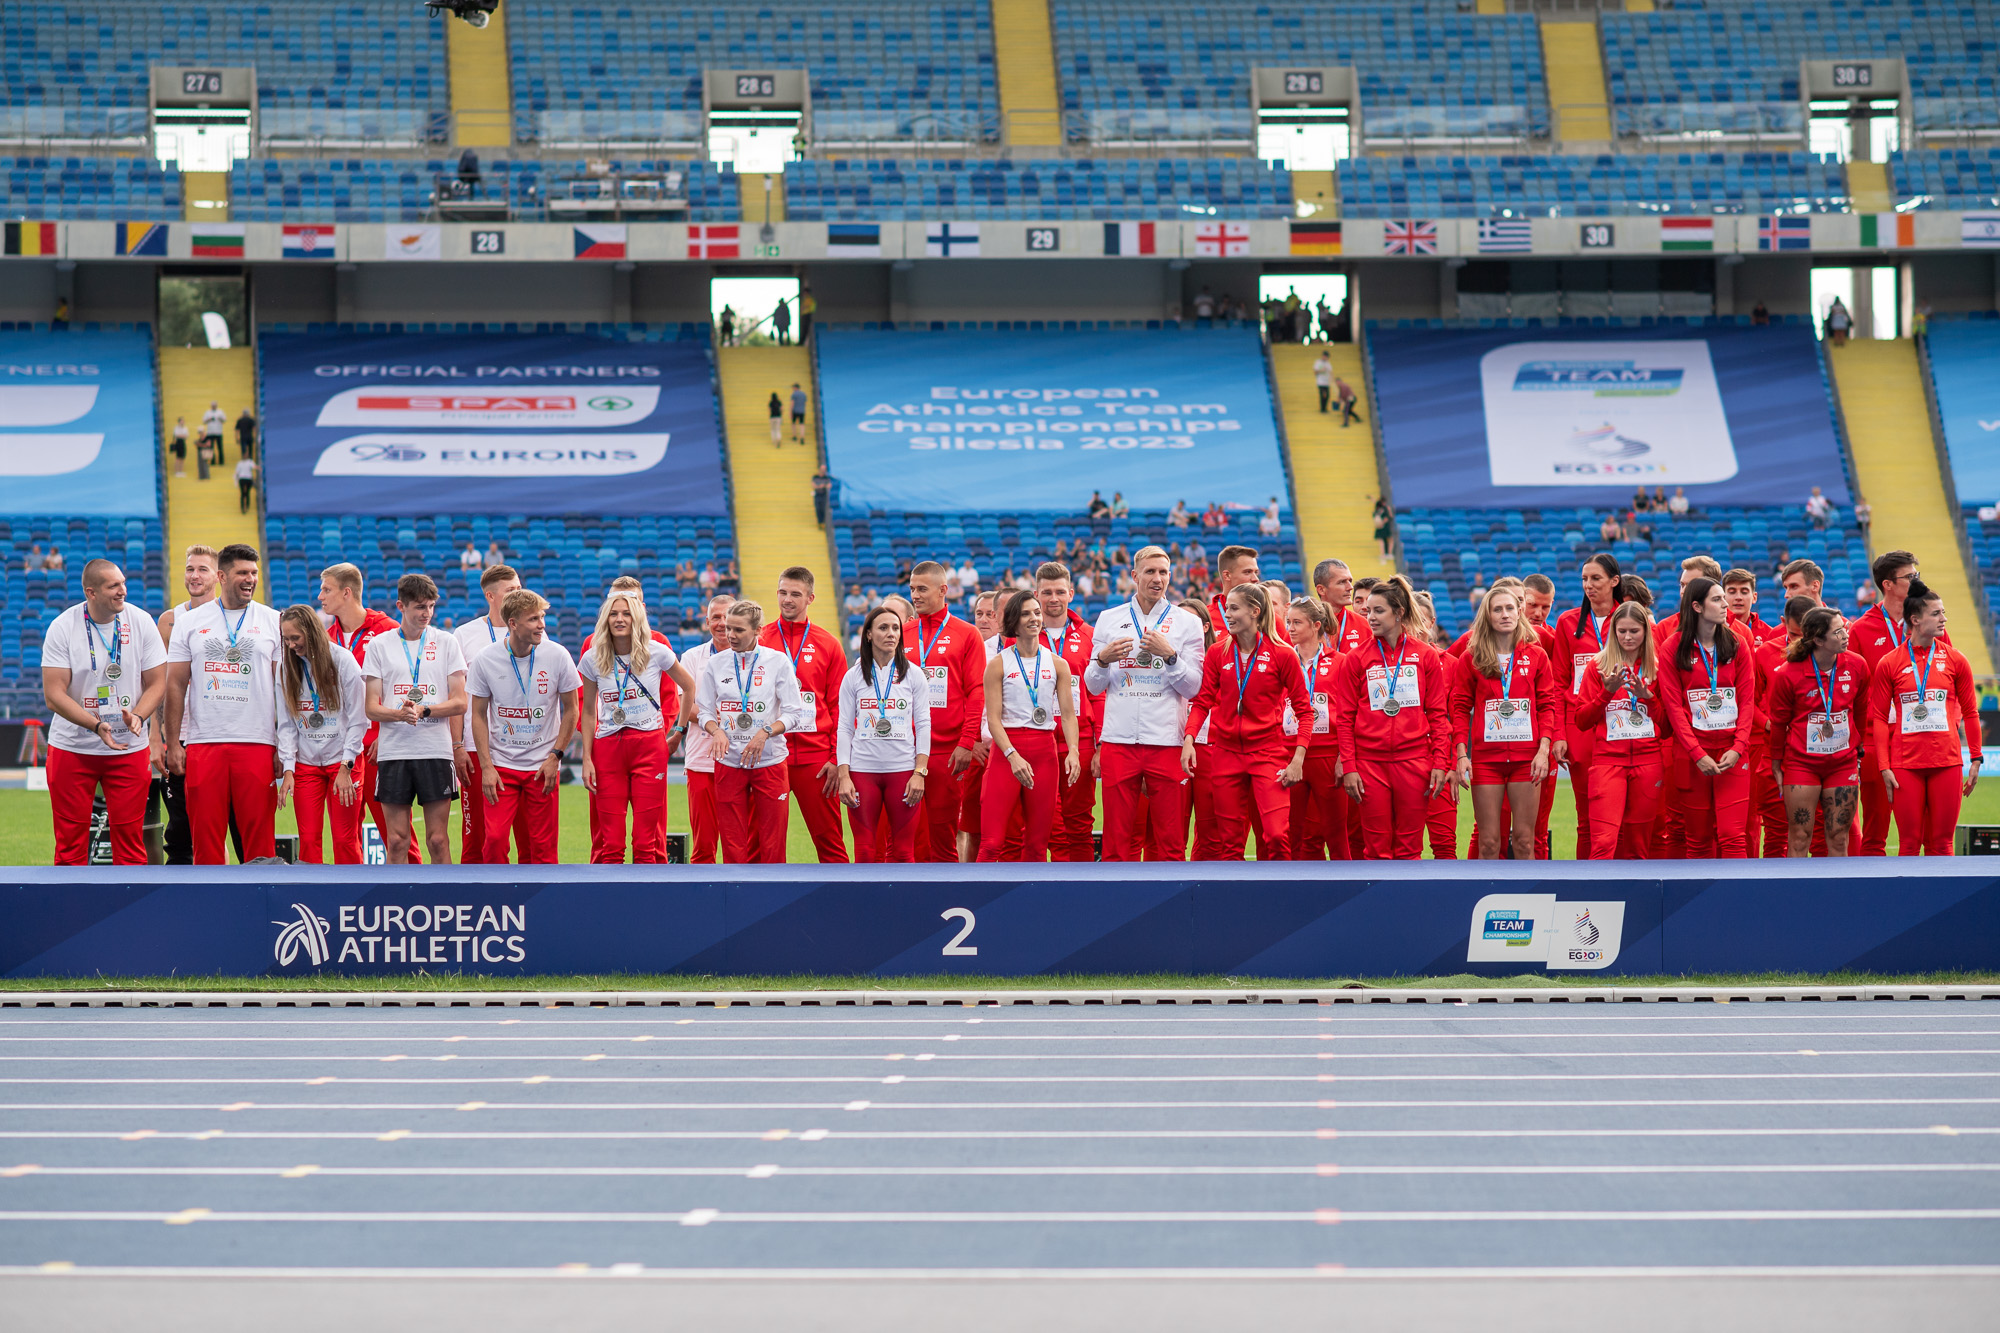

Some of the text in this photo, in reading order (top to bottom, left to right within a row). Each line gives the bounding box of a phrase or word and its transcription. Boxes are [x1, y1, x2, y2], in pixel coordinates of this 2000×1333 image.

[186, 74, 206, 91] 27
[1288, 75, 1307, 91] 29
[1836, 67, 1856, 84] 30
[739, 78, 758, 94] 28
[476, 232, 500, 252] 28
[1032, 230, 1054, 249] 29
[1586, 226, 1610, 245] 30
[315, 365, 661, 377] OFFICIAL PARTNERS
[1547, 369, 1652, 382] TEAM
[930, 386, 1159, 402] European
[408, 396, 573, 410] SPAR
[865, 402, 1227, 416] Athletics Team
[857, 418, 1242, 435] Championships
[909, 436, 1196, 451] Silesia 2023
[205, 662, 239, 673] SPAR
[394, 686, 427, 694] SPR
[861, 699, 895, 709] SPR
[1486, 701, 1520, 711] SPR
[1607, 701, 1632, 711] SPA
[462, 790, 472, 836] POLSKA
[368, 844, 386, 865] 75
[339, 905, 526, 932] EUROPEAN
[1492, 920, 1525, 930] TEAM
[941, 907, 978, 956] 2
[338, 936, 526, 963] ATHLETICS
